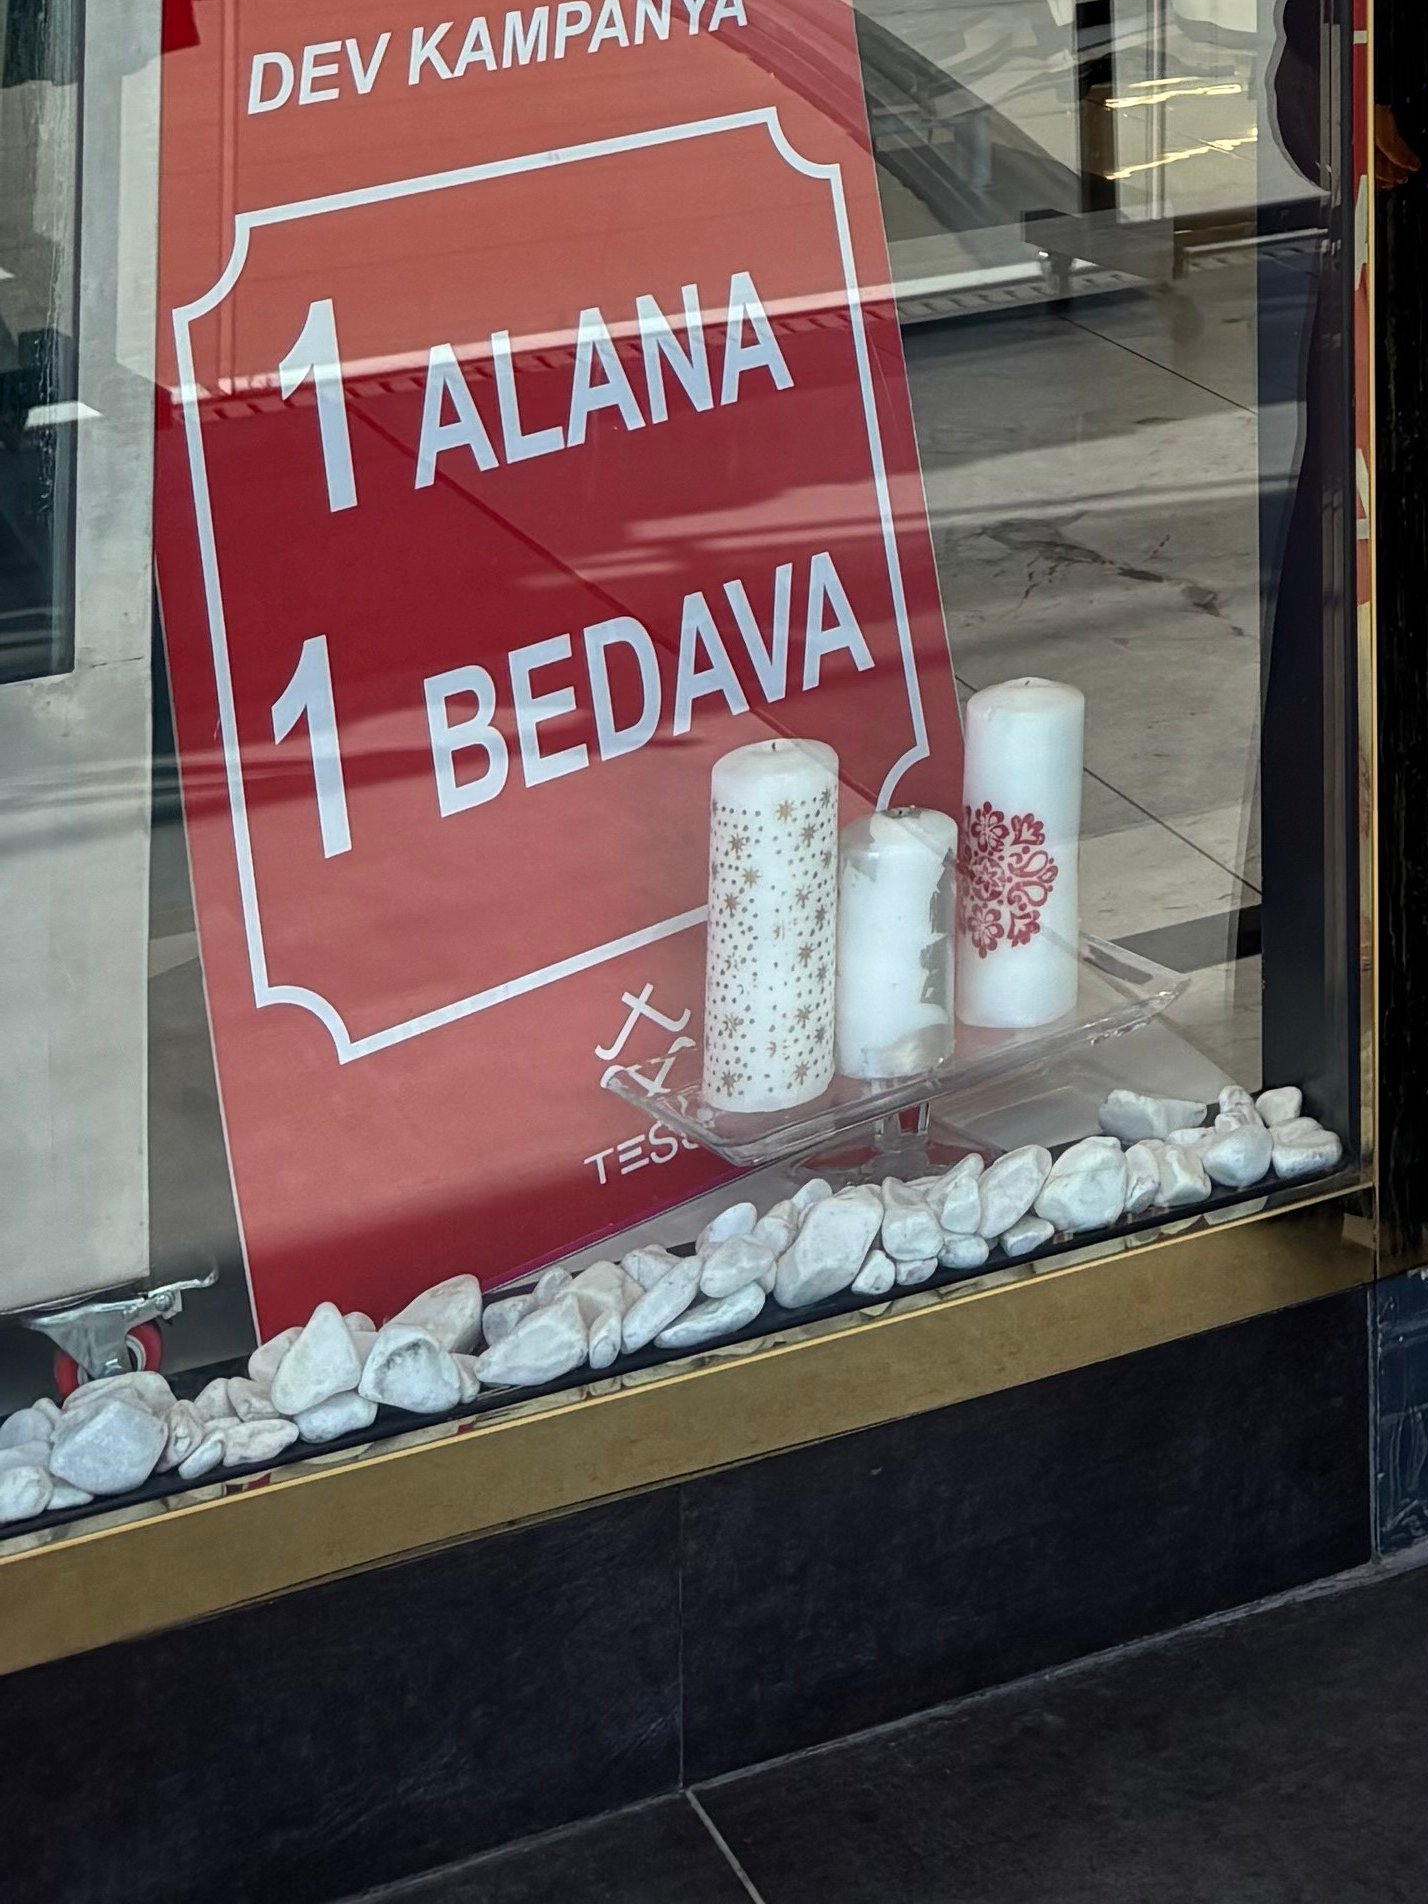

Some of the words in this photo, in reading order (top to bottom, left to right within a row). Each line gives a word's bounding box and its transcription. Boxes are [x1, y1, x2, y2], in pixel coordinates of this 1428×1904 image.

[247, 31, 392, 115] DEV
[278, 297, 358, 512] 1
[413, 270, 795, 490] ALANA
[271, 634, 353, 859] 1
[423, 551, 875, 819] BEDAVA
